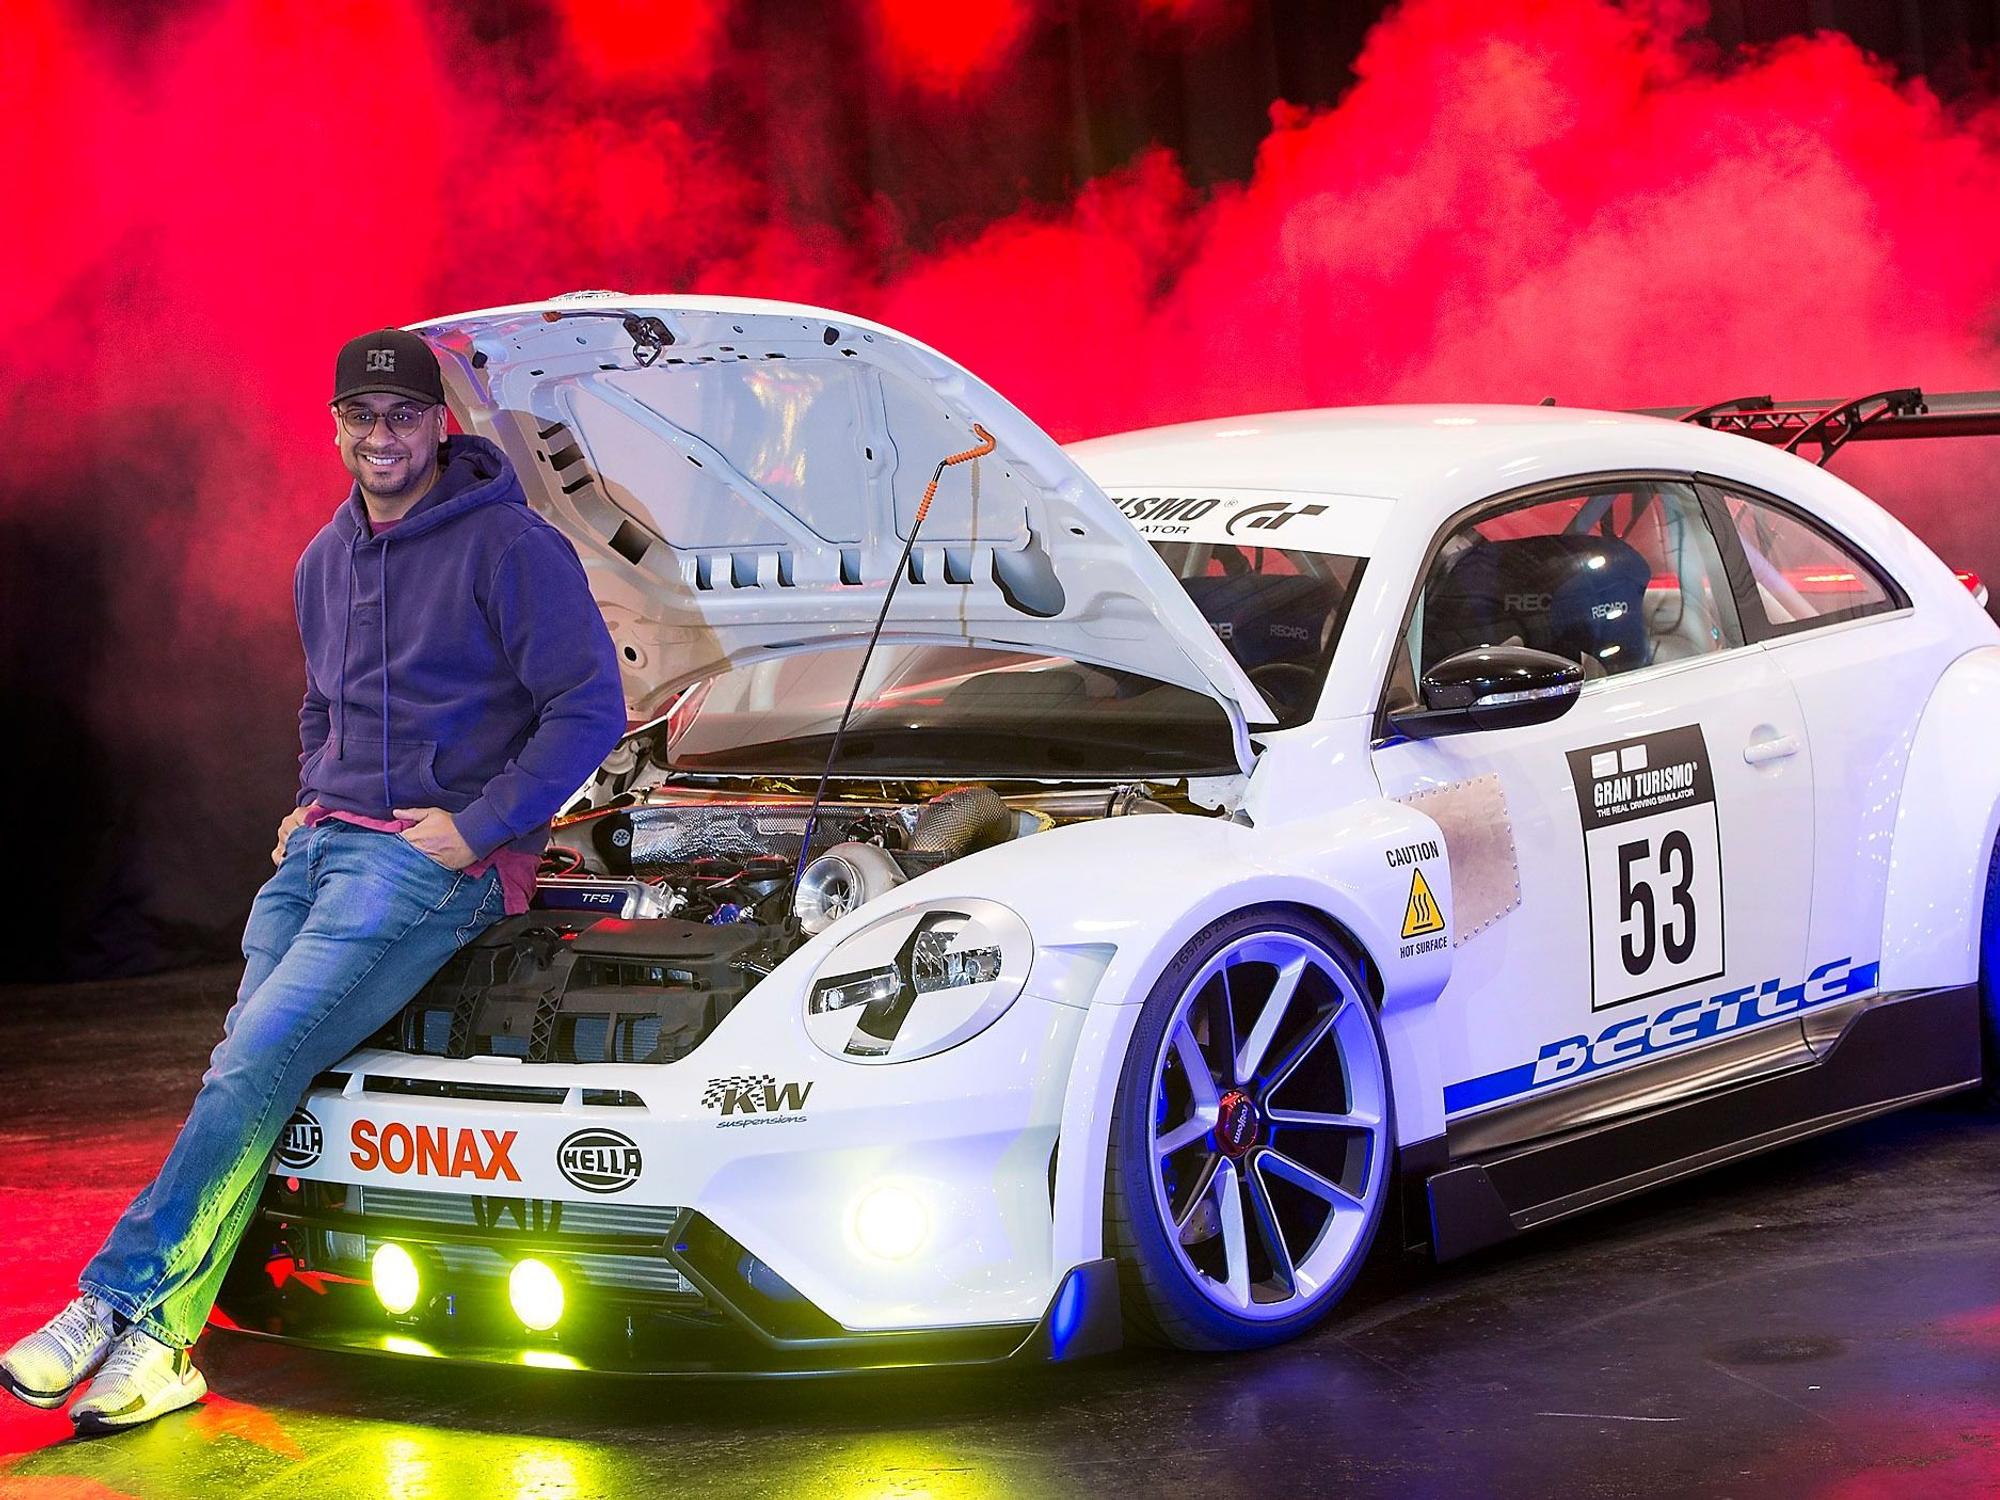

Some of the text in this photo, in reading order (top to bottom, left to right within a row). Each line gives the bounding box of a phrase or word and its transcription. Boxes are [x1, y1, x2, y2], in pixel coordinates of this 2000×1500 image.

[1111, 498, 1220, 521] ISMO
[1270, 624, 1309, 640] RECARO
[1594, 775, 1632, 808] GRAN
[1596, 788, 1694, 817] THE REAL DRIVING SIMULATOR
[1386, 840, 1439, 868] CAUTION
[582, 893, 615, 904] TFSI
[1618, 830, 1696, 976] 53
[1400, 936, 1448, 959] HOT SURFACE
[1532, 957, 1852, 1085] BEETLE
[721, 1082, 814, 1116] KW
[716, 1115, 807, 1128] suspensions
[284, 1126, 323, 1154] ELLA
[350, 1119, 522, 1183] SONAX
[564, 1148, 643, 1178] HELLA
